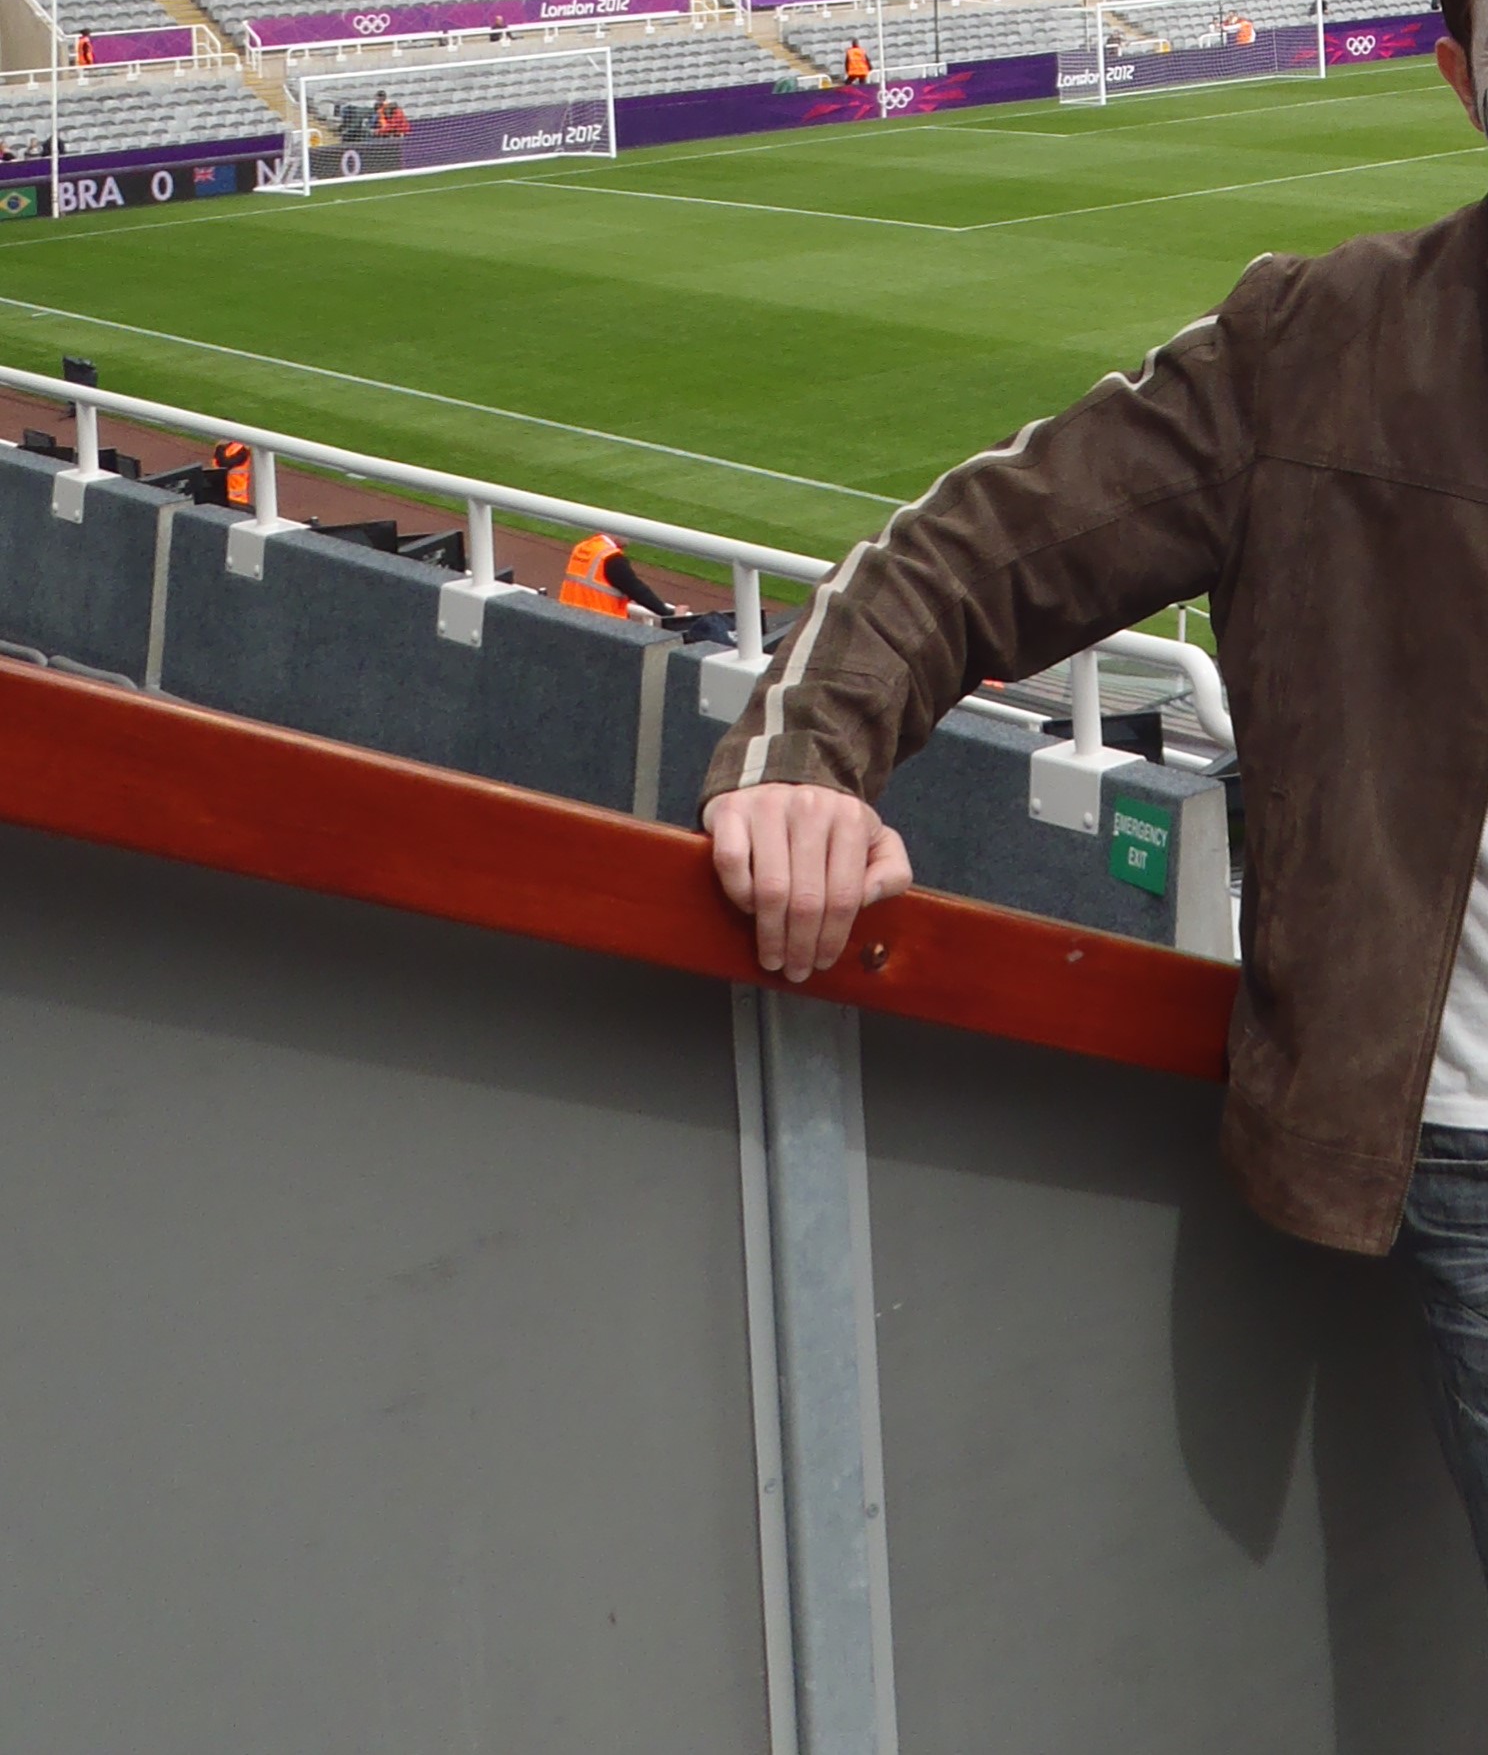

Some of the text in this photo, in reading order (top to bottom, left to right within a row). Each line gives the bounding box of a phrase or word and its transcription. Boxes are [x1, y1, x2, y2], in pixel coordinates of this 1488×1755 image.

[541, 0, 595, 18] London
[1105, 64, 1135, 82] 2012
[501, 124, 602, 152] London 2012
[58, 149, 361, 213] BRA 0 NZ 0
[1113, 811, 1168, 848] EMERGENCY
[1128, 846, 1148, 870] EXIT
